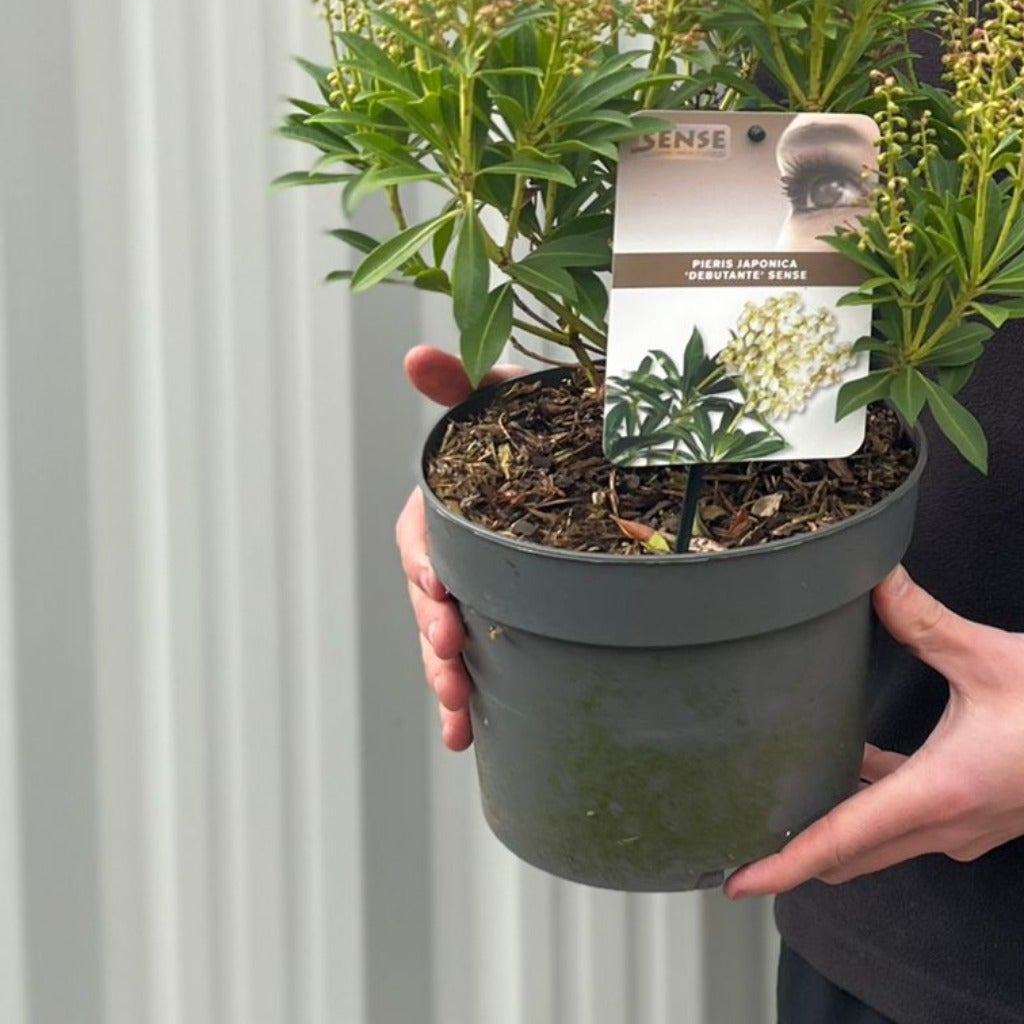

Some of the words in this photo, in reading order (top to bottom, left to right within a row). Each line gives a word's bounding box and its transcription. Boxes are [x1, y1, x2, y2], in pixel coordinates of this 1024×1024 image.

[630, 129, 726, 154] SENSE
[691, 258, 734, 269] PIERIS
[736, 258, 798, 269] JAPONICA
[767, 270, 808, 280] SENSE
